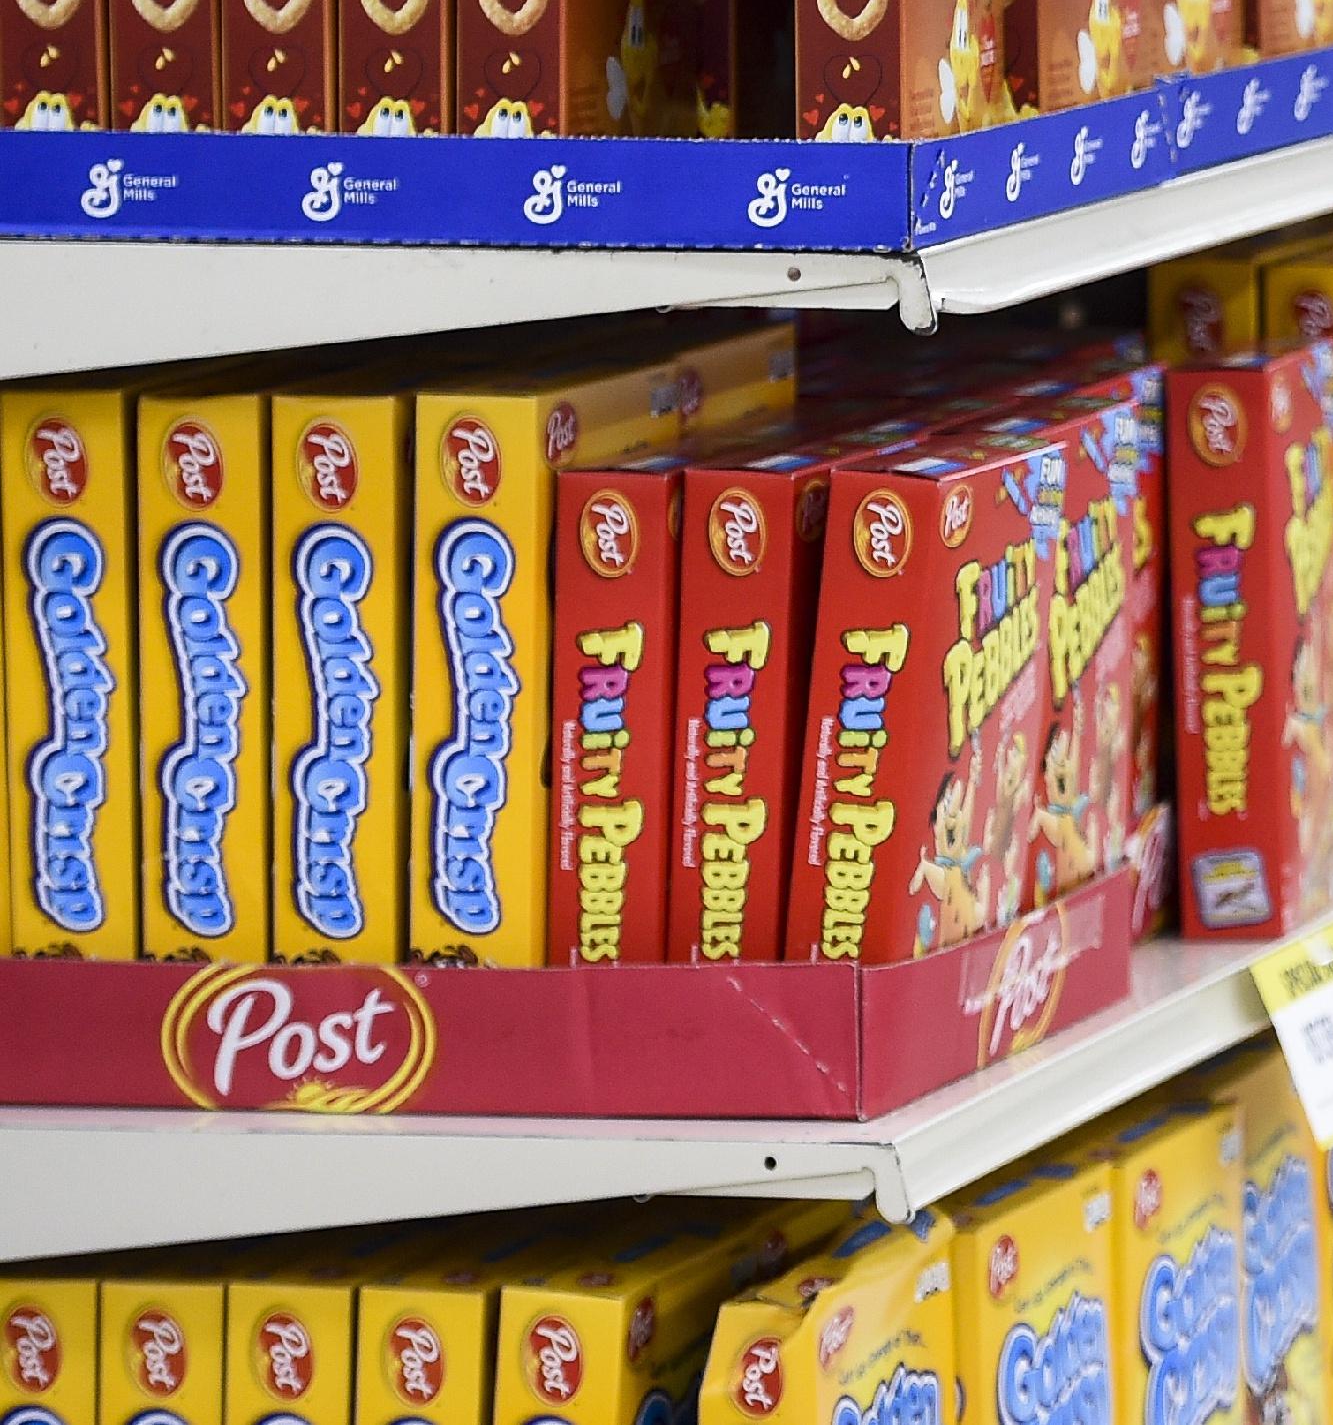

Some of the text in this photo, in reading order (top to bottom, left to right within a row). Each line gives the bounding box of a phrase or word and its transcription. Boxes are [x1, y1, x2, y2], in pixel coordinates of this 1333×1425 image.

[123, 174, 177, 189] General
[124, 188, 155, 202] Mills
[343, 177, 398, 192] General
[344, 191, 375, 205] Mills
[567, 180, 622, 194] General
[567, 194, 599, 208] Mills
[791, 183, 846, 197] General
[791, 197, 824, 211] Mills
[1200, 395, 1236, 454] Post
[37, 426, 79, 497] Post
[171, 430, 214, 504] Post
[307, 431, 349, 504] Post
[450, 425, 494, 500] Post
[591, 501, 630, 566] Post
[720, 501, 760, 566] Post
[866, 501, 904, 568] Post
[944, 492, 970, 540] Post
[40, 530, 111, 929] Golden Crisp
[172, 532, 244, 931] Golden Crisp
[305, 536, 376, 933] Golden Crisp
[444, 531, 516, 928] Golden Crisp
[577, 798, 645, 963] PEBBLES
[702, 797, 767, 961] PEBBLES
[822, 797, 896, 961] PEBBLES
[989, 930, 1066, 1057] Post
[206, 977, 395, 1096] Post
[10, 1308, 51, 1387] Post
[138, 1312, 180, 1390] Post
[266, 1317, 310, 1394] Post
[395, 1321, 441, 1399] Post
[537, 1319, 579, 1400] Post
[743, 1342, 779, 1409] Post
